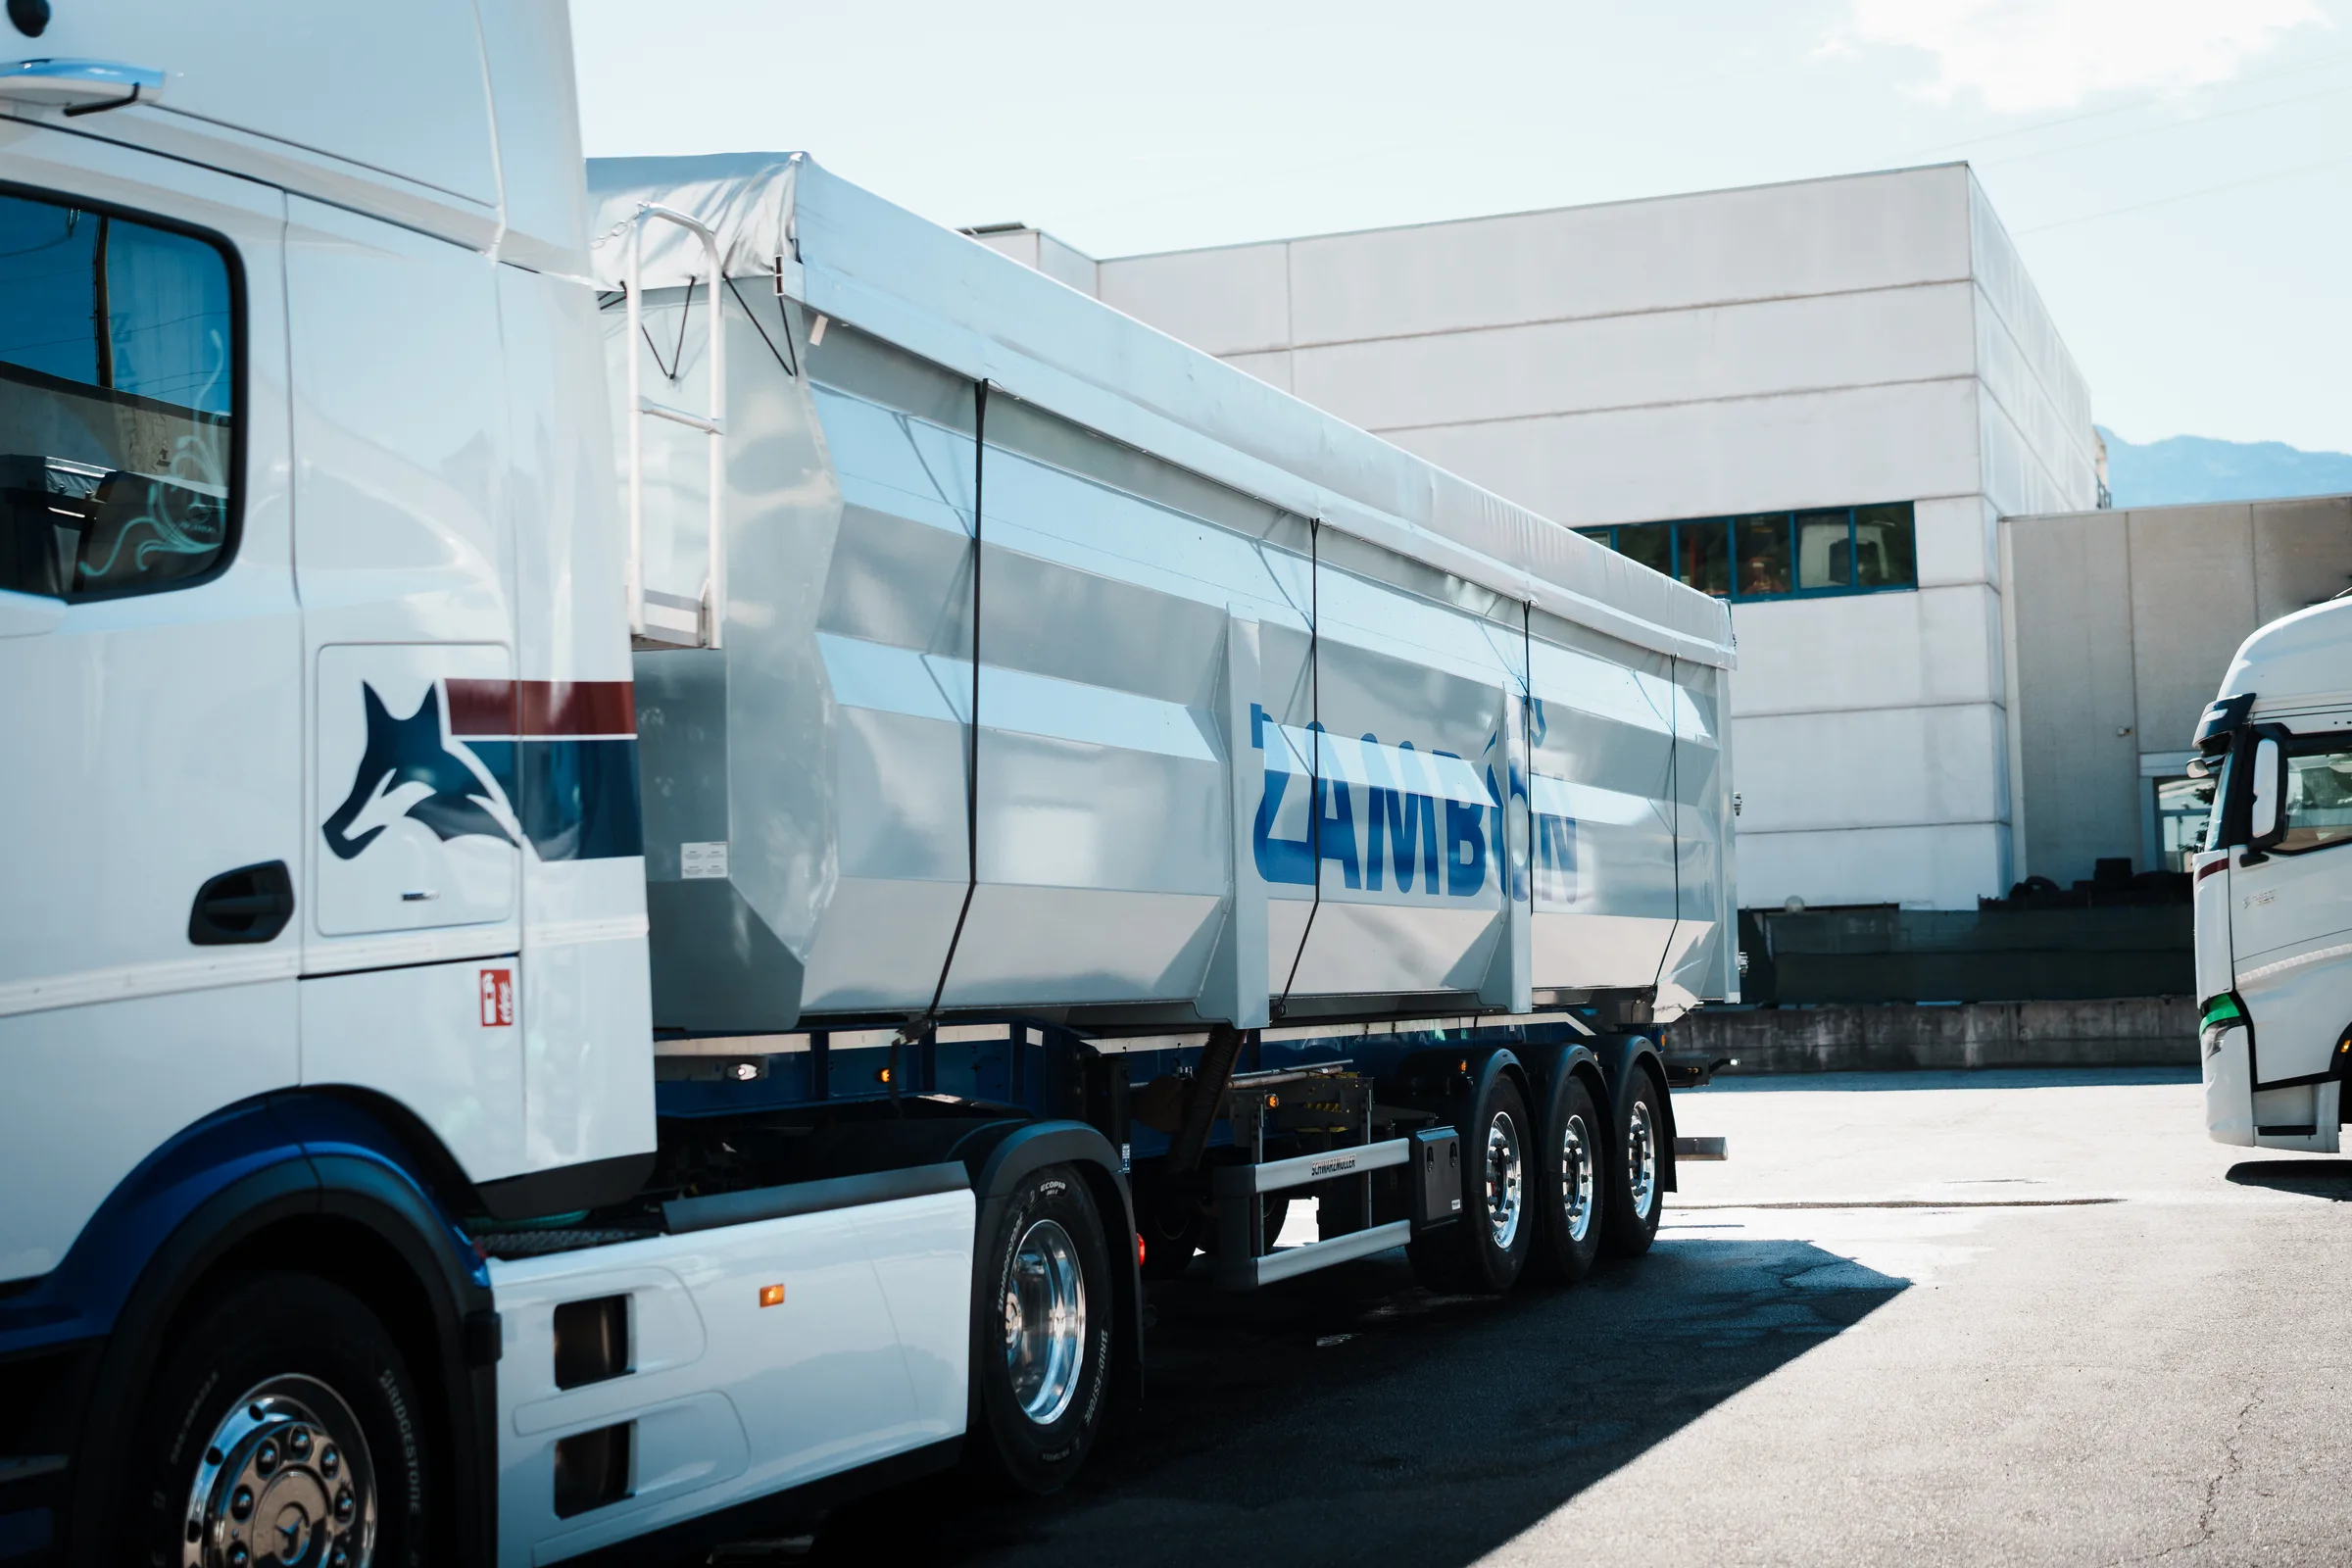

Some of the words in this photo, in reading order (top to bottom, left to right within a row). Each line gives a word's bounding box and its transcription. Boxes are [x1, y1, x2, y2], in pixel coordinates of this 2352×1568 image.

[1250, 703, 1578, 905] ZAMBON
[379, 1368, 420, 1514] BRIDGESTONE
[1084, 1328, 1108, 1427] BRIDGESTONE
